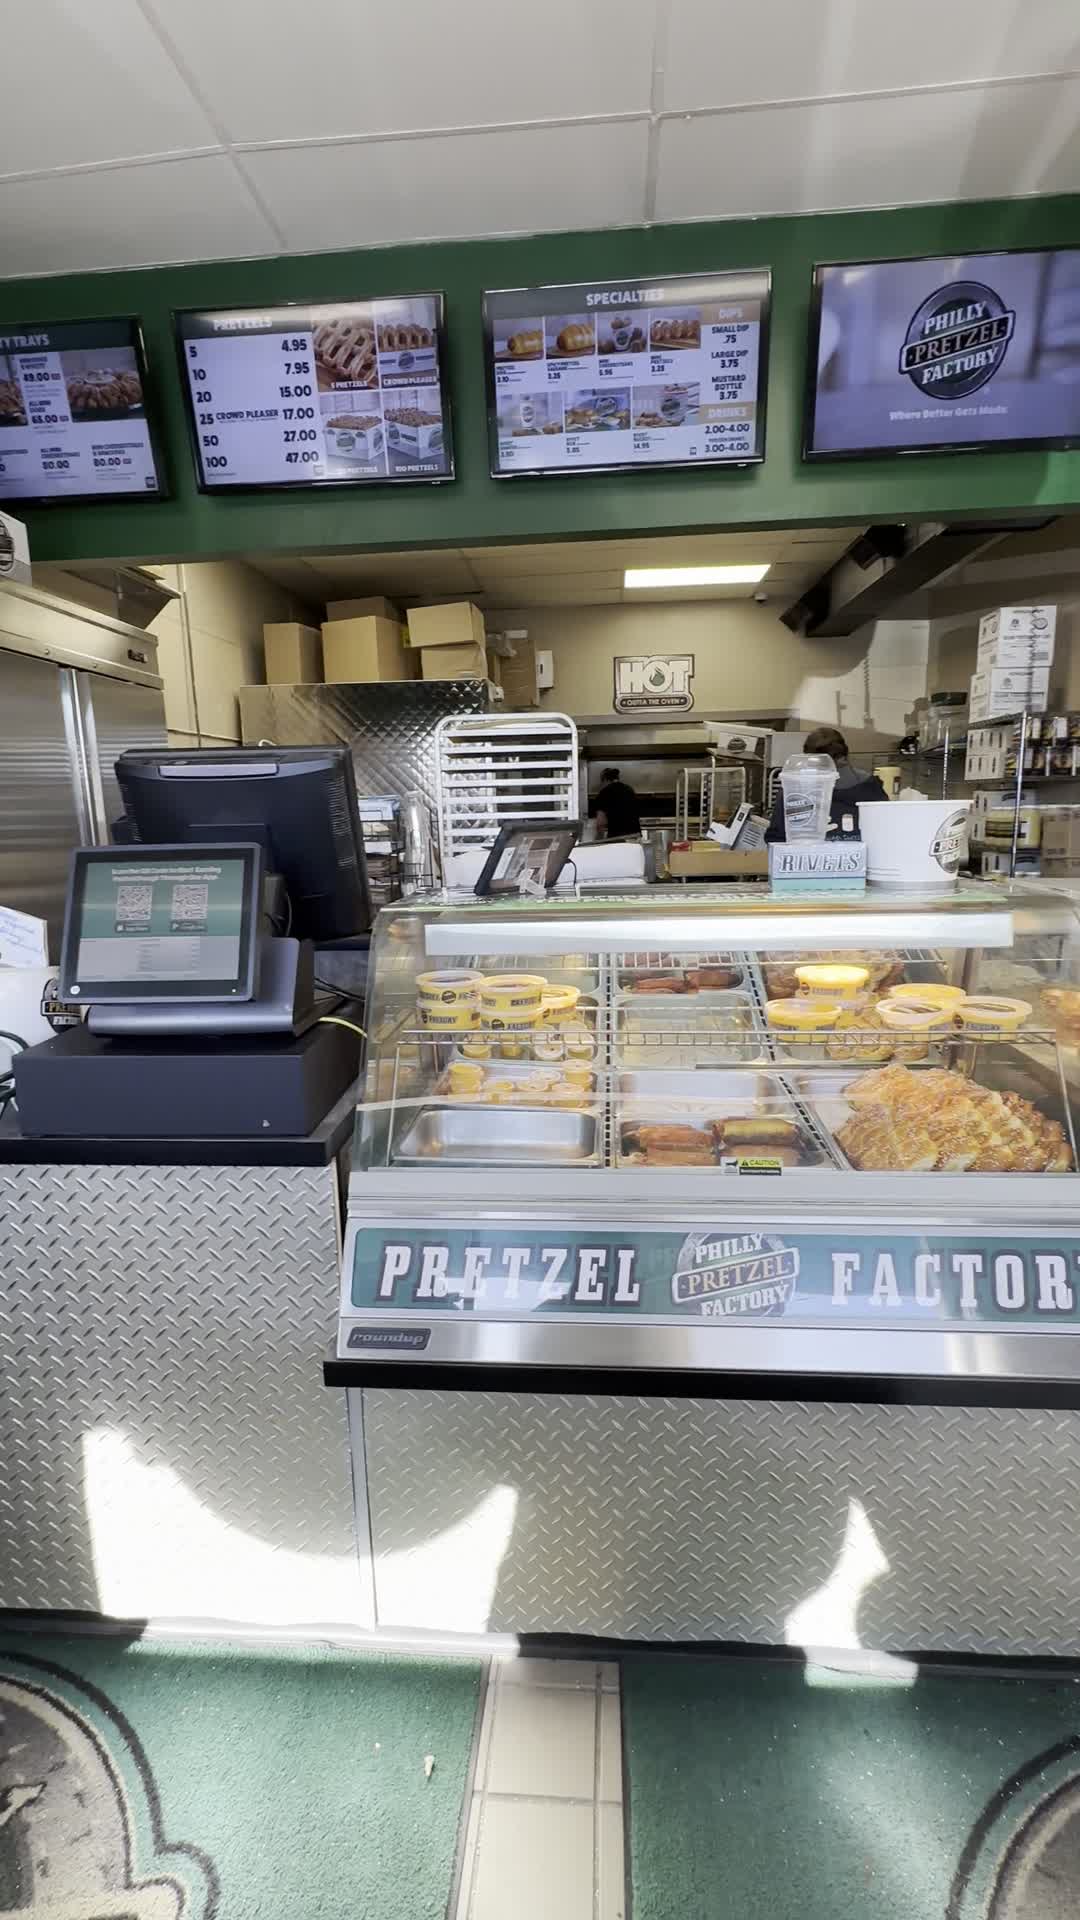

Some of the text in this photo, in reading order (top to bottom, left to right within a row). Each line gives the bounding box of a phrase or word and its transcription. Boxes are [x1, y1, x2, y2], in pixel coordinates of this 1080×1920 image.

[585, 289, 665, 306] SPECIALTIES
[923, 301, 987, 335] PHILLY
[711, 325, 737, 334] SMALL
[189, 338, 308, 358] 5 4.95
[913, 322, 1002, 364] PRETZEL
[711, 351, 736, 359] LARGE
[720, 359, 739, 369] 3.75
[193, 361, 311, 381] 10 7.95
[921, 345, 999, 385] FACTORY
[711, 374, 746, 383] MUSTARD
[196, 385, 313, 404] 20 15.00
[719, 391, 738, 400] 3.75
[199, 407, 315, 426] 25 CROWD PLEASER 17.00
[922, 408, 953, 418] Better
[954, 407, 978, 418] Gets
[203, 429, 317, 447] 50 27.00
[704, 423, 750, 434] 2.00-4.00
[704, 441, 750, 453] 3.00-4.00
[206, 450, 320, 469] 100 47.00
[619, 660, 690, 694] HOT
[779, 853, 862, 873] RIVETS
[694, 1232, 764, 1264] PHILLY
[378, 1244, 1080, 1311] PRETZEL FACTOR
[687, 1254, 790, 1295] PRETZEL
[700, 1283, 790, 1317] FACTORY
[352, 1333, 424, 1346] roundup
